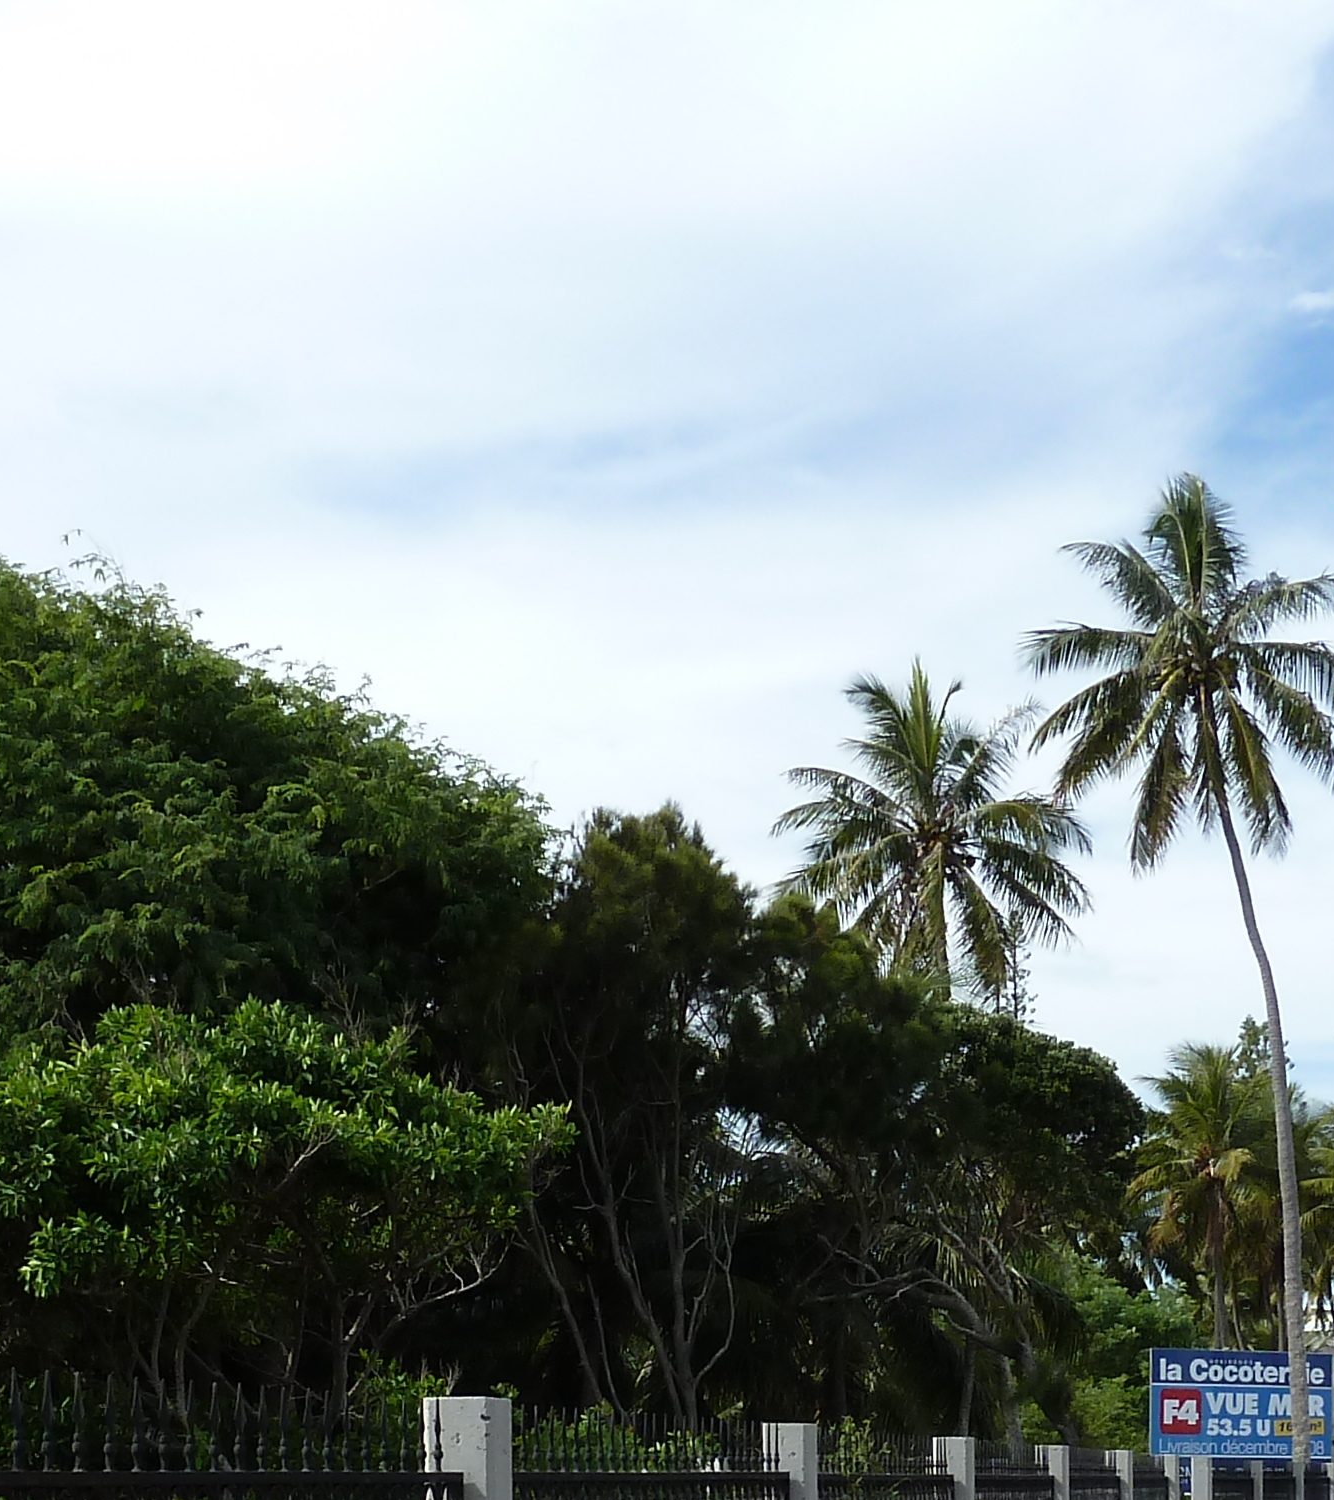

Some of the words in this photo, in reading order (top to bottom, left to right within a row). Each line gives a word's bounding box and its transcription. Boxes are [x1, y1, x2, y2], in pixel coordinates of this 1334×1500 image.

[1159, 1358, 1182, 1381] la
[1189, 1358, 1325, 1385] Cocoterie
[1163, 1399, 1200, 1425] F4
[1206, 1392, 1259, 1415] VUE
[1268, 1393, 1325, 1417] MR
[1207, 1418, 1252, 1437] 53.5
[1257, 1419, 1271, 1437] U
[1158, 1438, 1218, 1454] Livraison
[1221, 1439, 1289, 1455] décembre
